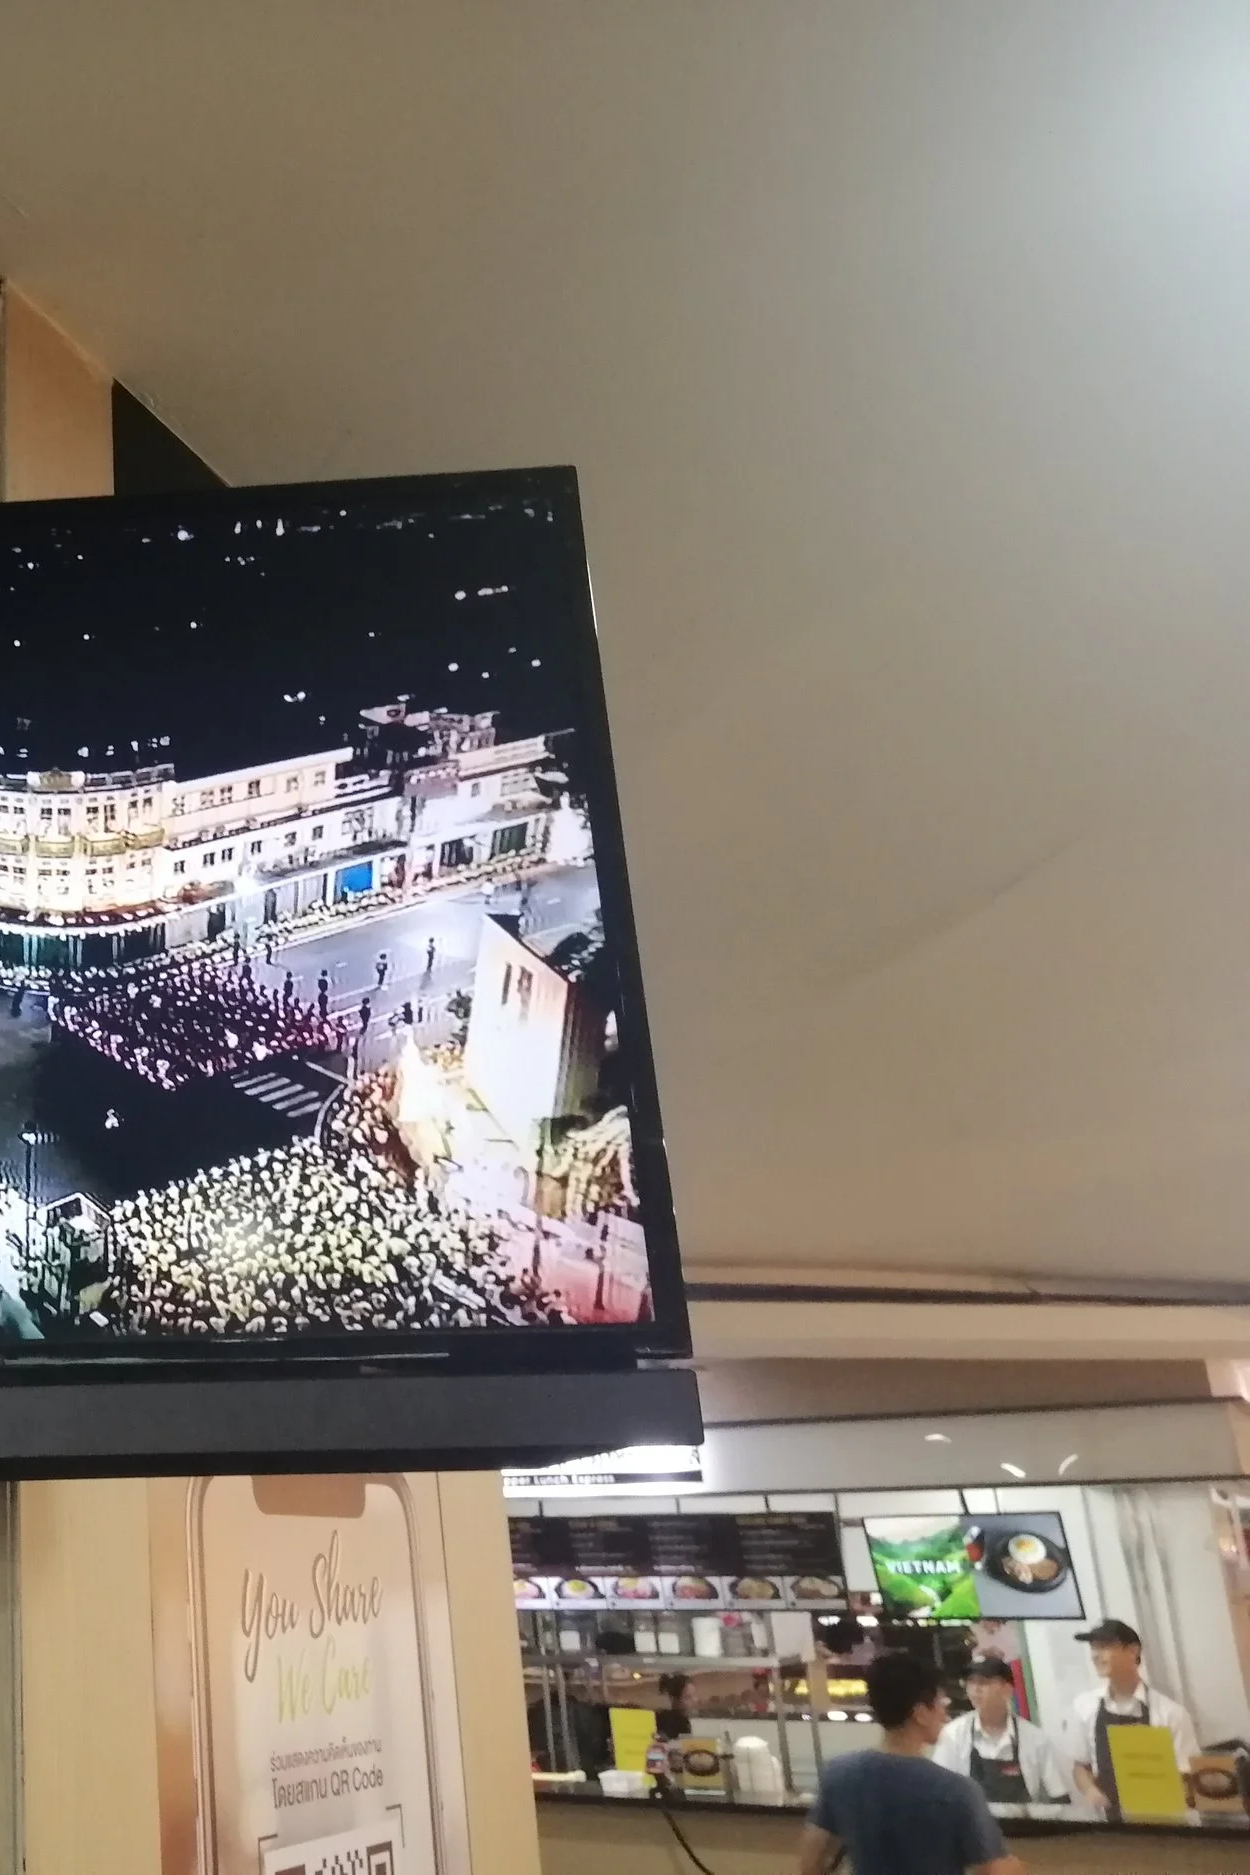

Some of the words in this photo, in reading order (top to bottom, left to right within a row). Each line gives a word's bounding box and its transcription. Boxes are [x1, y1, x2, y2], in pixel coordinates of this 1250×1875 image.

[885, 1559, 963, 1574] VIETNAM
[240, 1567, 299, 1683] You
[309, 1528, 383, 1639] Share
[276, 1648, 311, 1724] We
[322, 1633, 372, 1715] Care
[271, 1777, 327, 1809] โดยสแกน
[330, 1769, 350, 1797] QR
[352, 1763, 384, 1793] Code
